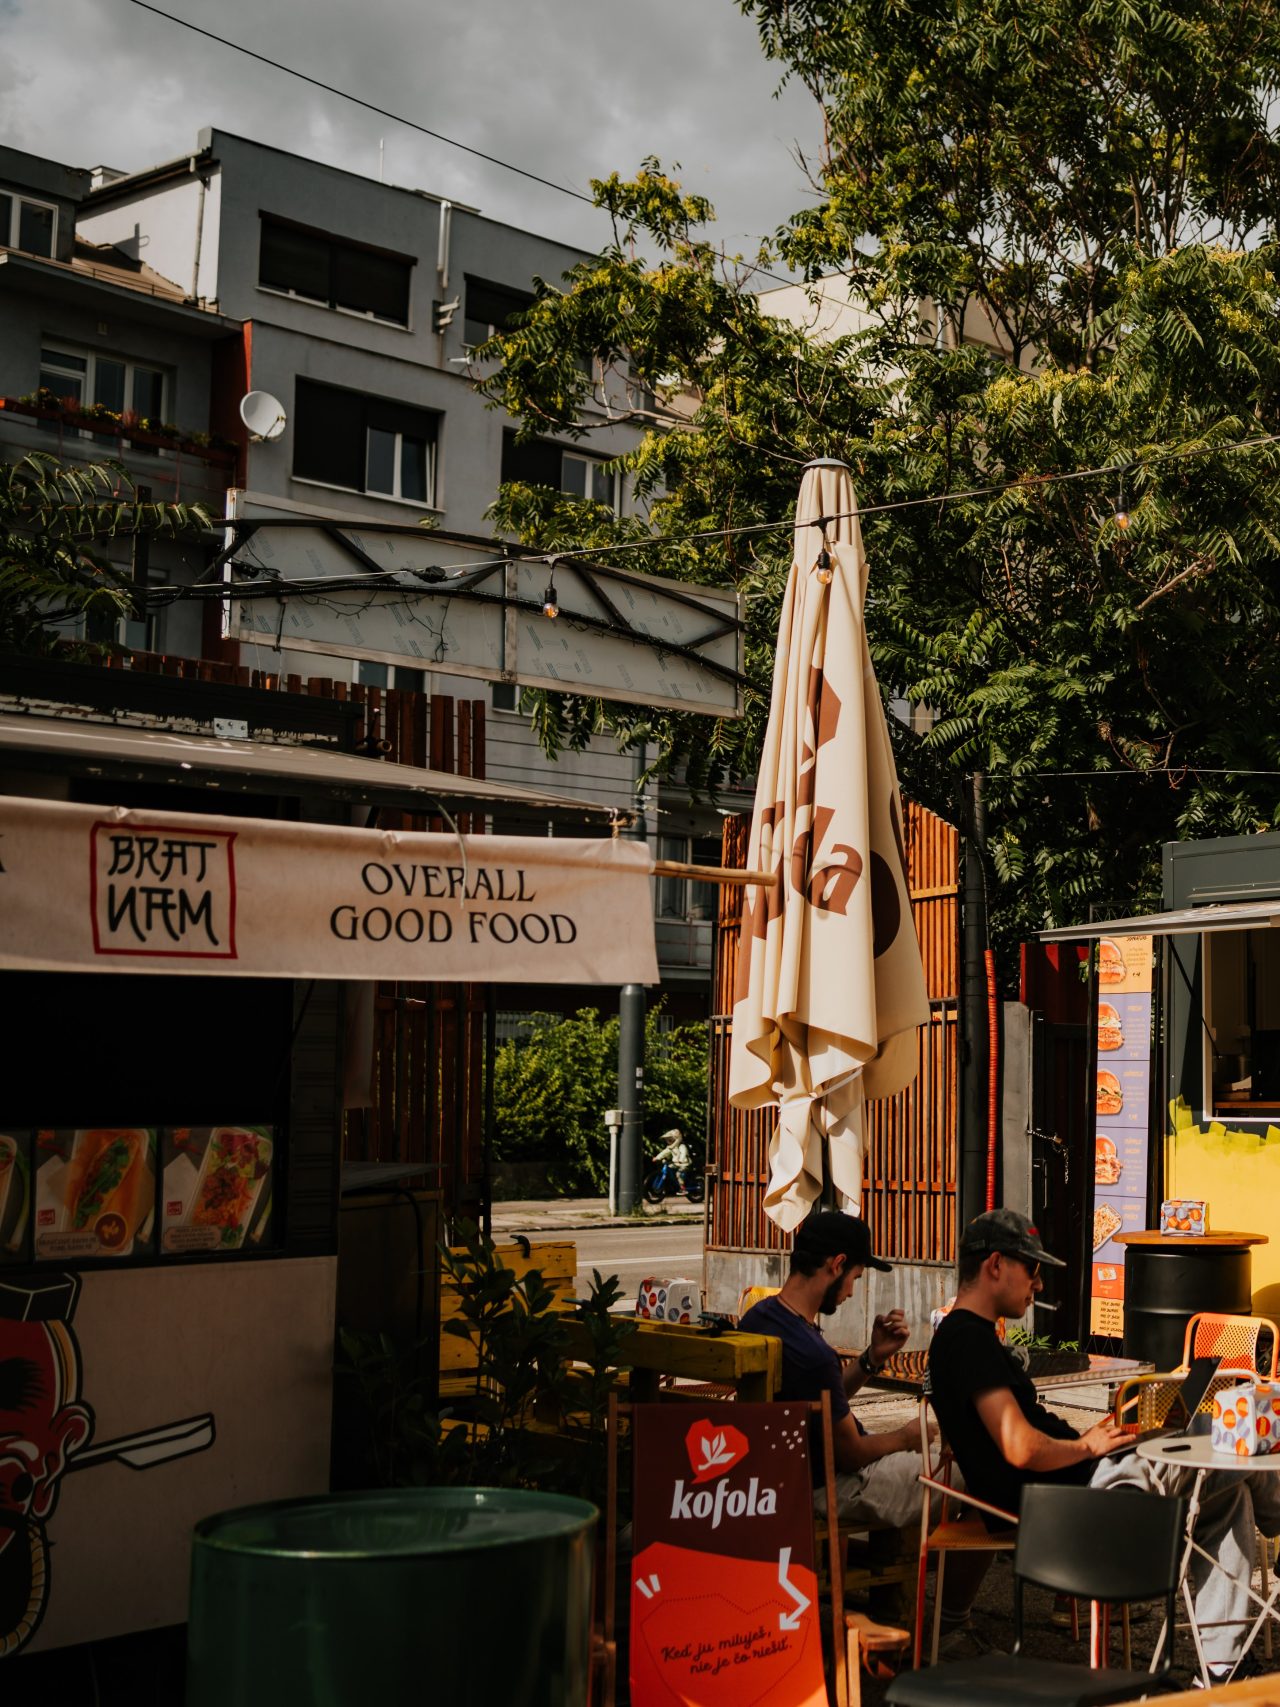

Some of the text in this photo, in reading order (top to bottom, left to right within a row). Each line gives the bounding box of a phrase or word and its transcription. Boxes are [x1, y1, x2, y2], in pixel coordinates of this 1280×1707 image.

[108, 835, 217, 883] BRAT
[361, 861, 536, 903] OVERALL
[330, 904, 578, 945] GOOD FOOD
[670, 1477, 777, 1530] kofola
[661, 1625, 772, 1662] Keď ju miluješ,
[690, 1662, 713, 1675] nie
[711, 1656, 730, 1676] je
[733, 1650, 751, 1665] čo
